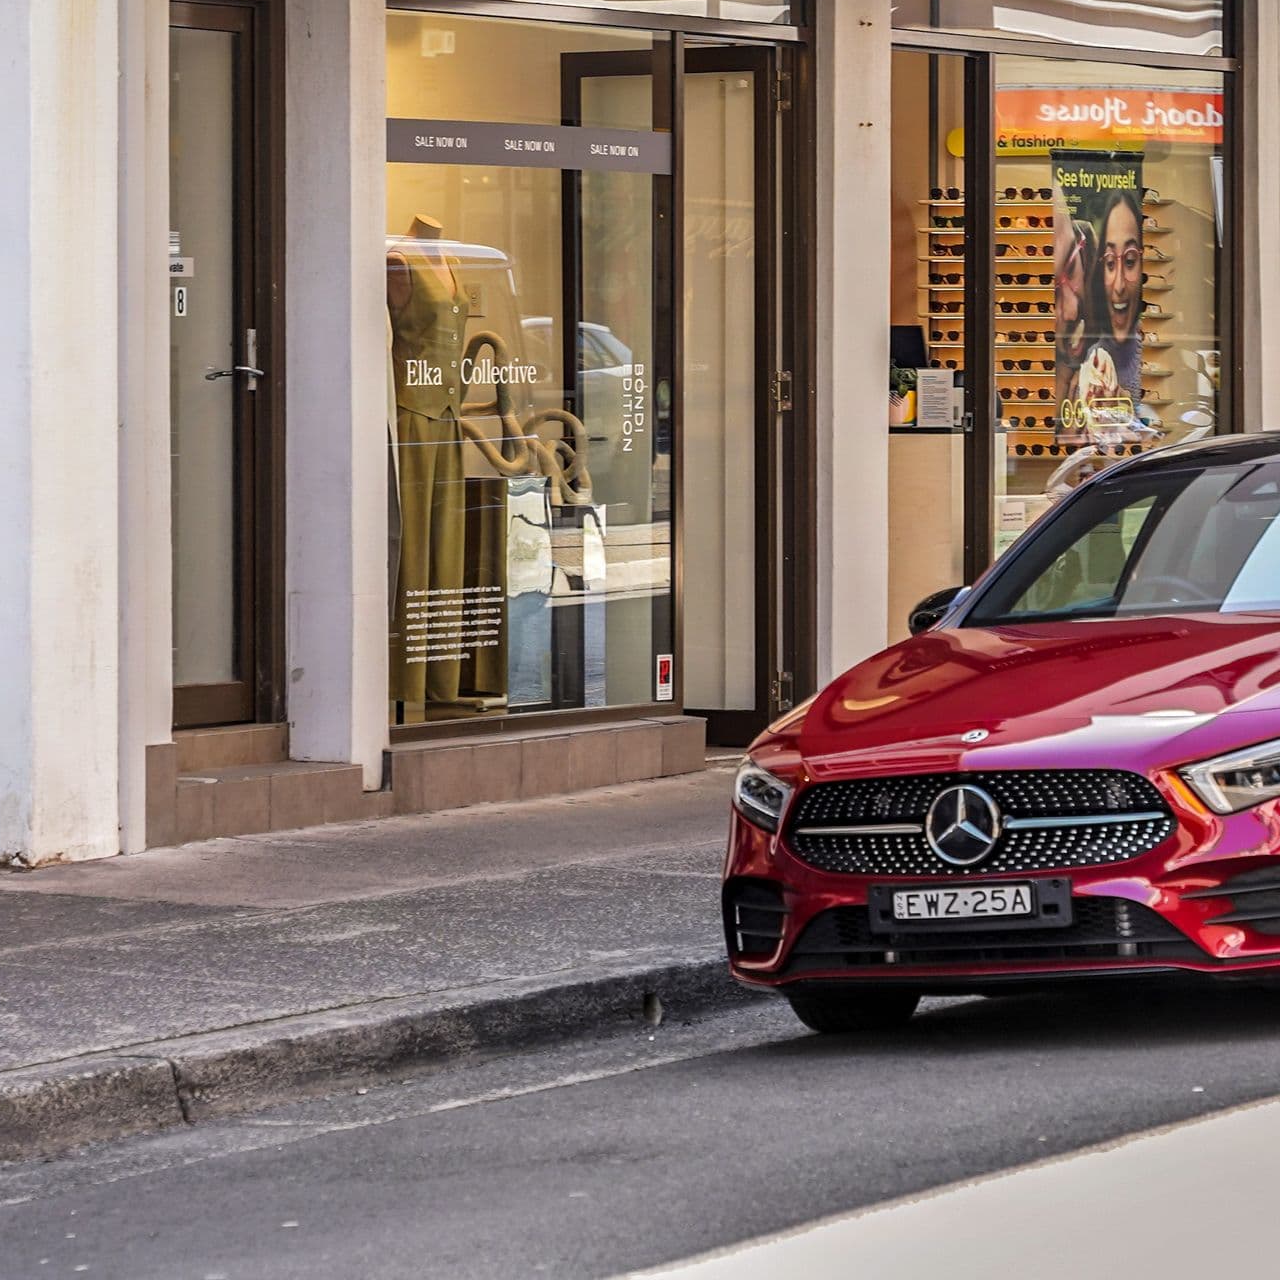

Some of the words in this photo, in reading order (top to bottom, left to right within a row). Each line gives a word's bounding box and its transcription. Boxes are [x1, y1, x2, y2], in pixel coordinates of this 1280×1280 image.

[414, 135, 434, 148] SALE
[436, 136, 455, 149] NOW
[456, 137, 468, 149] ON
[504, 139, 523, 152] SALE
[524, 140, 542, 152] NOW
[543, 141, 556, 153] ON
[590, 143, 608, 156] SALE
[609, 145, 626, 157] NOW
[627, 146, 639, 158] ON
[1011, 134, 1066, 148] fashion
[1056, 167, 1079, 188] See
[1080, 169, 1095, 188] for
[1095, 169, 1137, 193] yourself.
[177, 288, 185, 314] 8
[405, 358, 443, 386] Elka
[460, 356, 538, 386] Collective
[632, 363, 646, 433] BONDI
